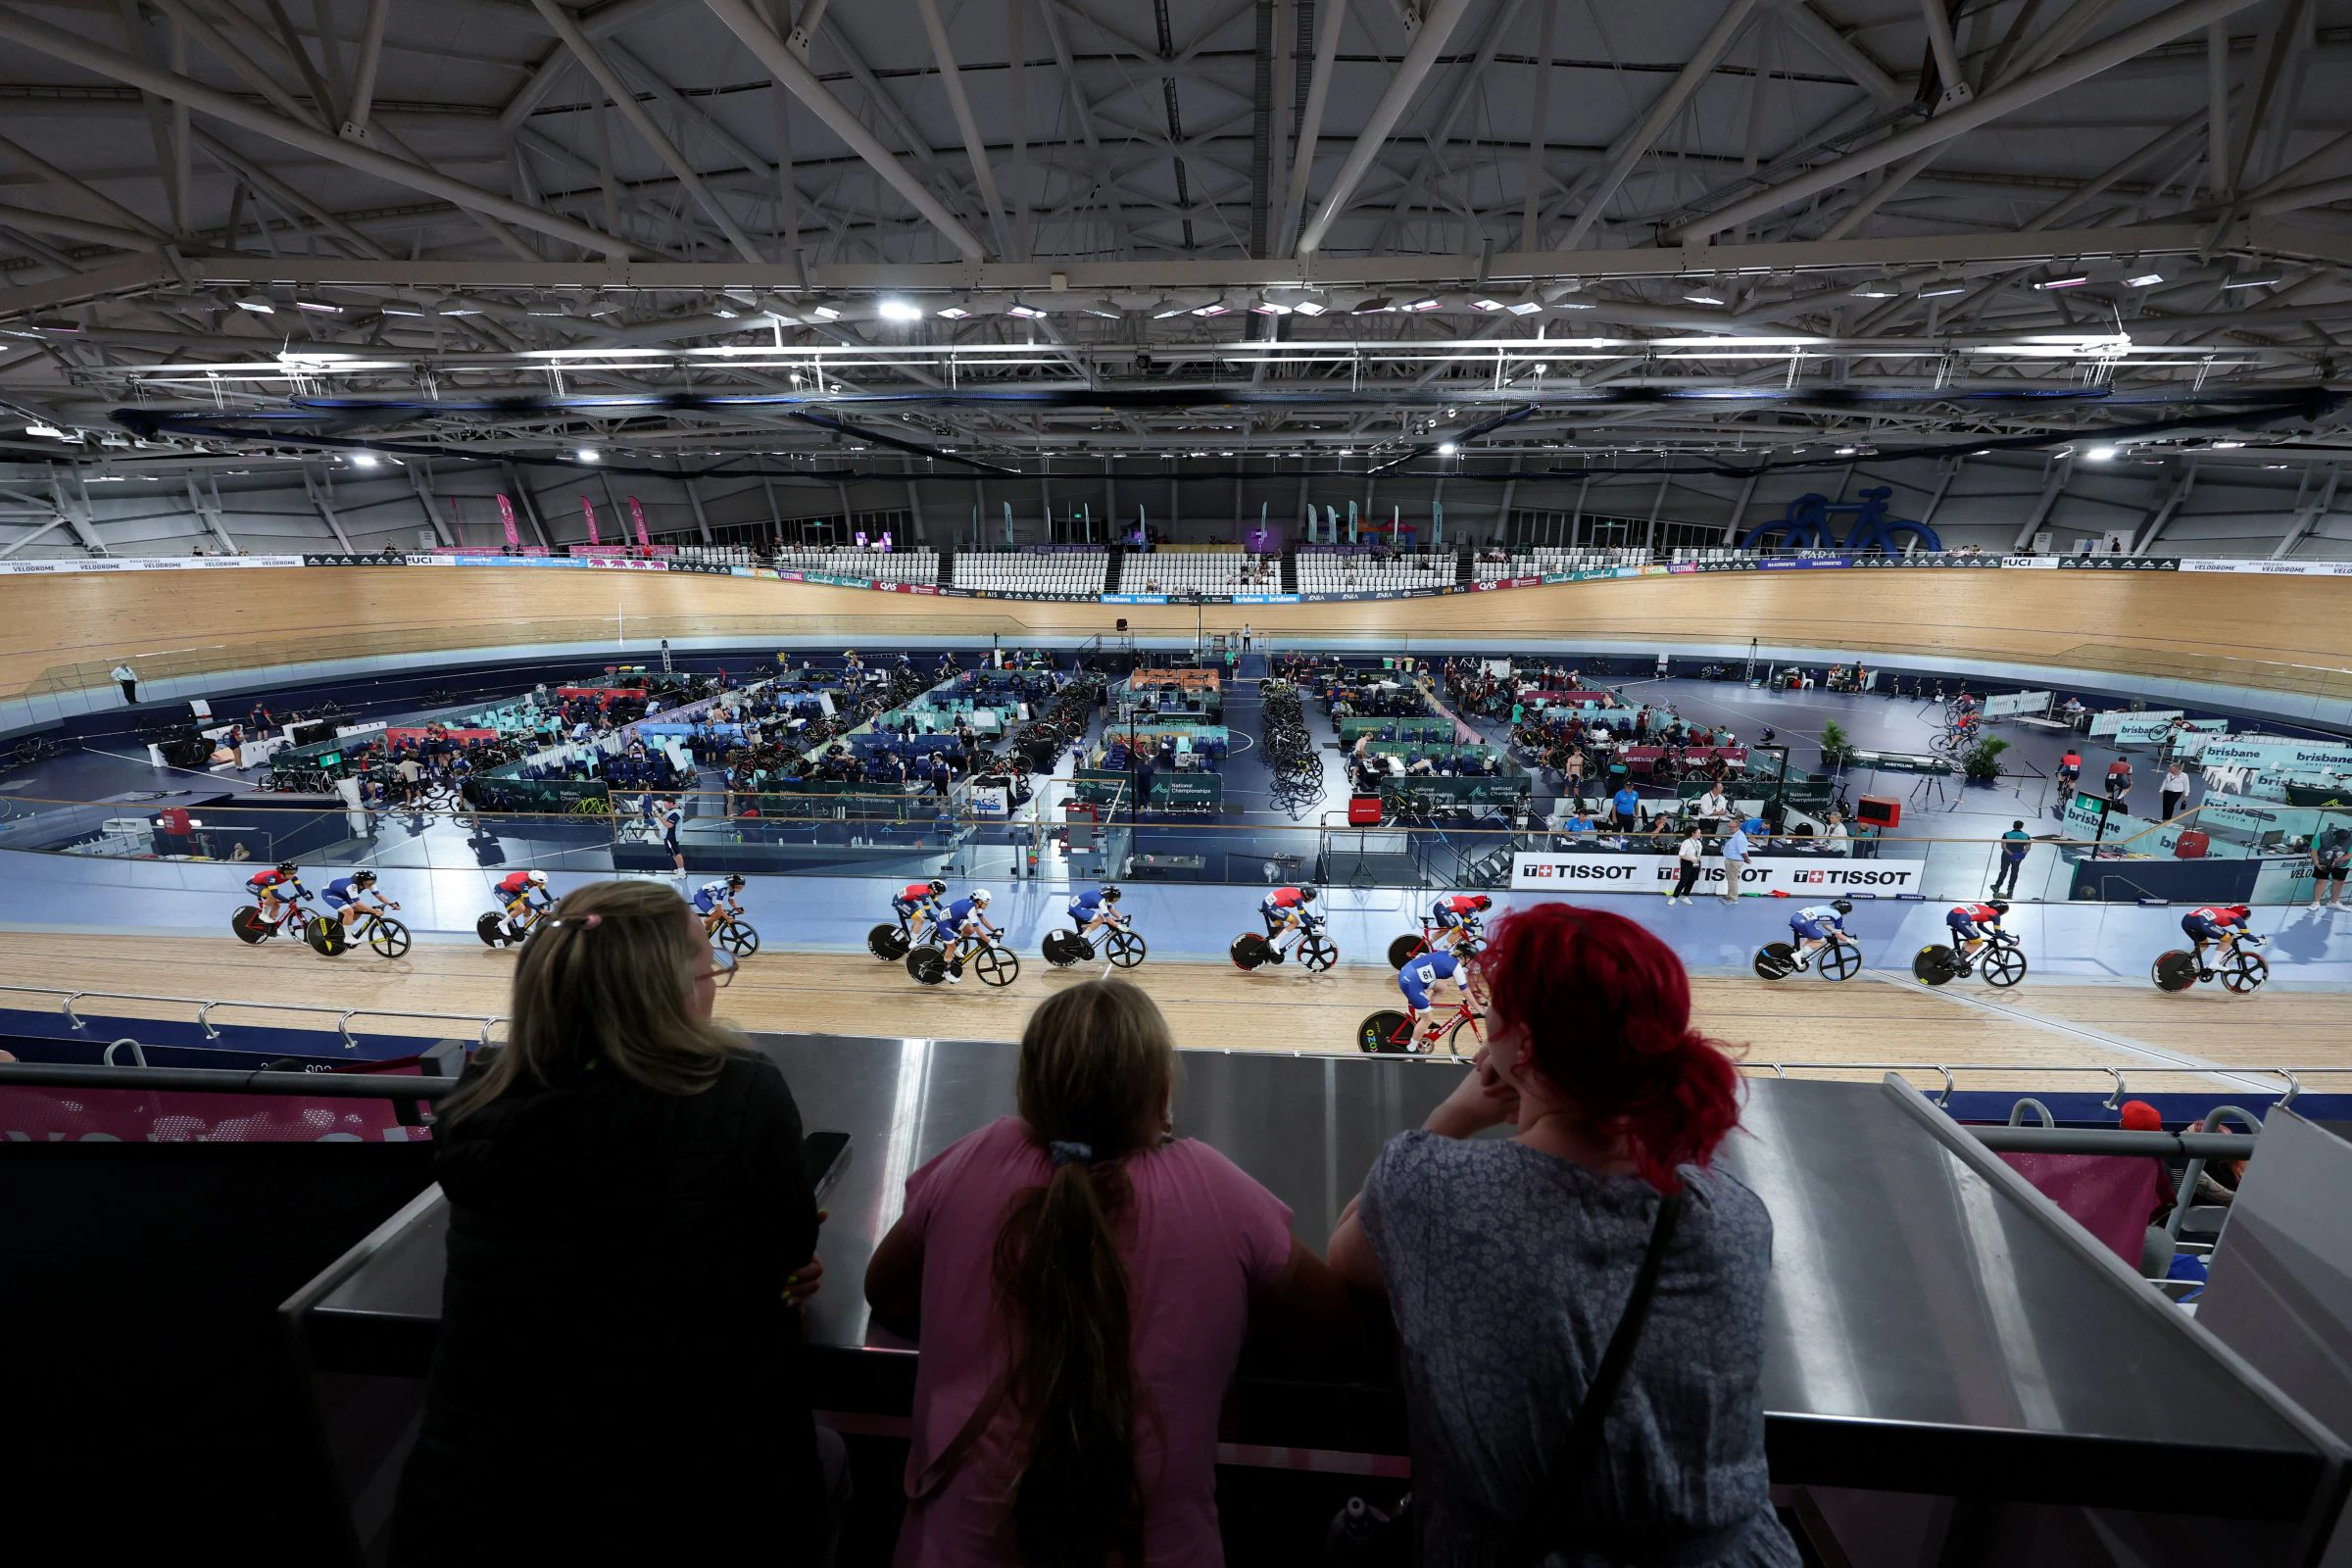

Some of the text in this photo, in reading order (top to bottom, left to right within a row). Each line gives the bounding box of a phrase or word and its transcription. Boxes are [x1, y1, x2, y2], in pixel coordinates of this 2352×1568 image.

[1670, 564, 1695, 572] FESTIVAL
[781, 571, 803, 580] FESTIVAL
[880, 582, 897, 592] QAS
[1479, 580, 1497, 591] QAS
[2207, 747, 2260, 759] brisbane
[1171, 786, 1211, 795] Championships
[1555, 865, 1637, 880] TISSOT
[1827, 870, 1911, 885] TISSOT
[1422, 970, 1433, 981] 81
